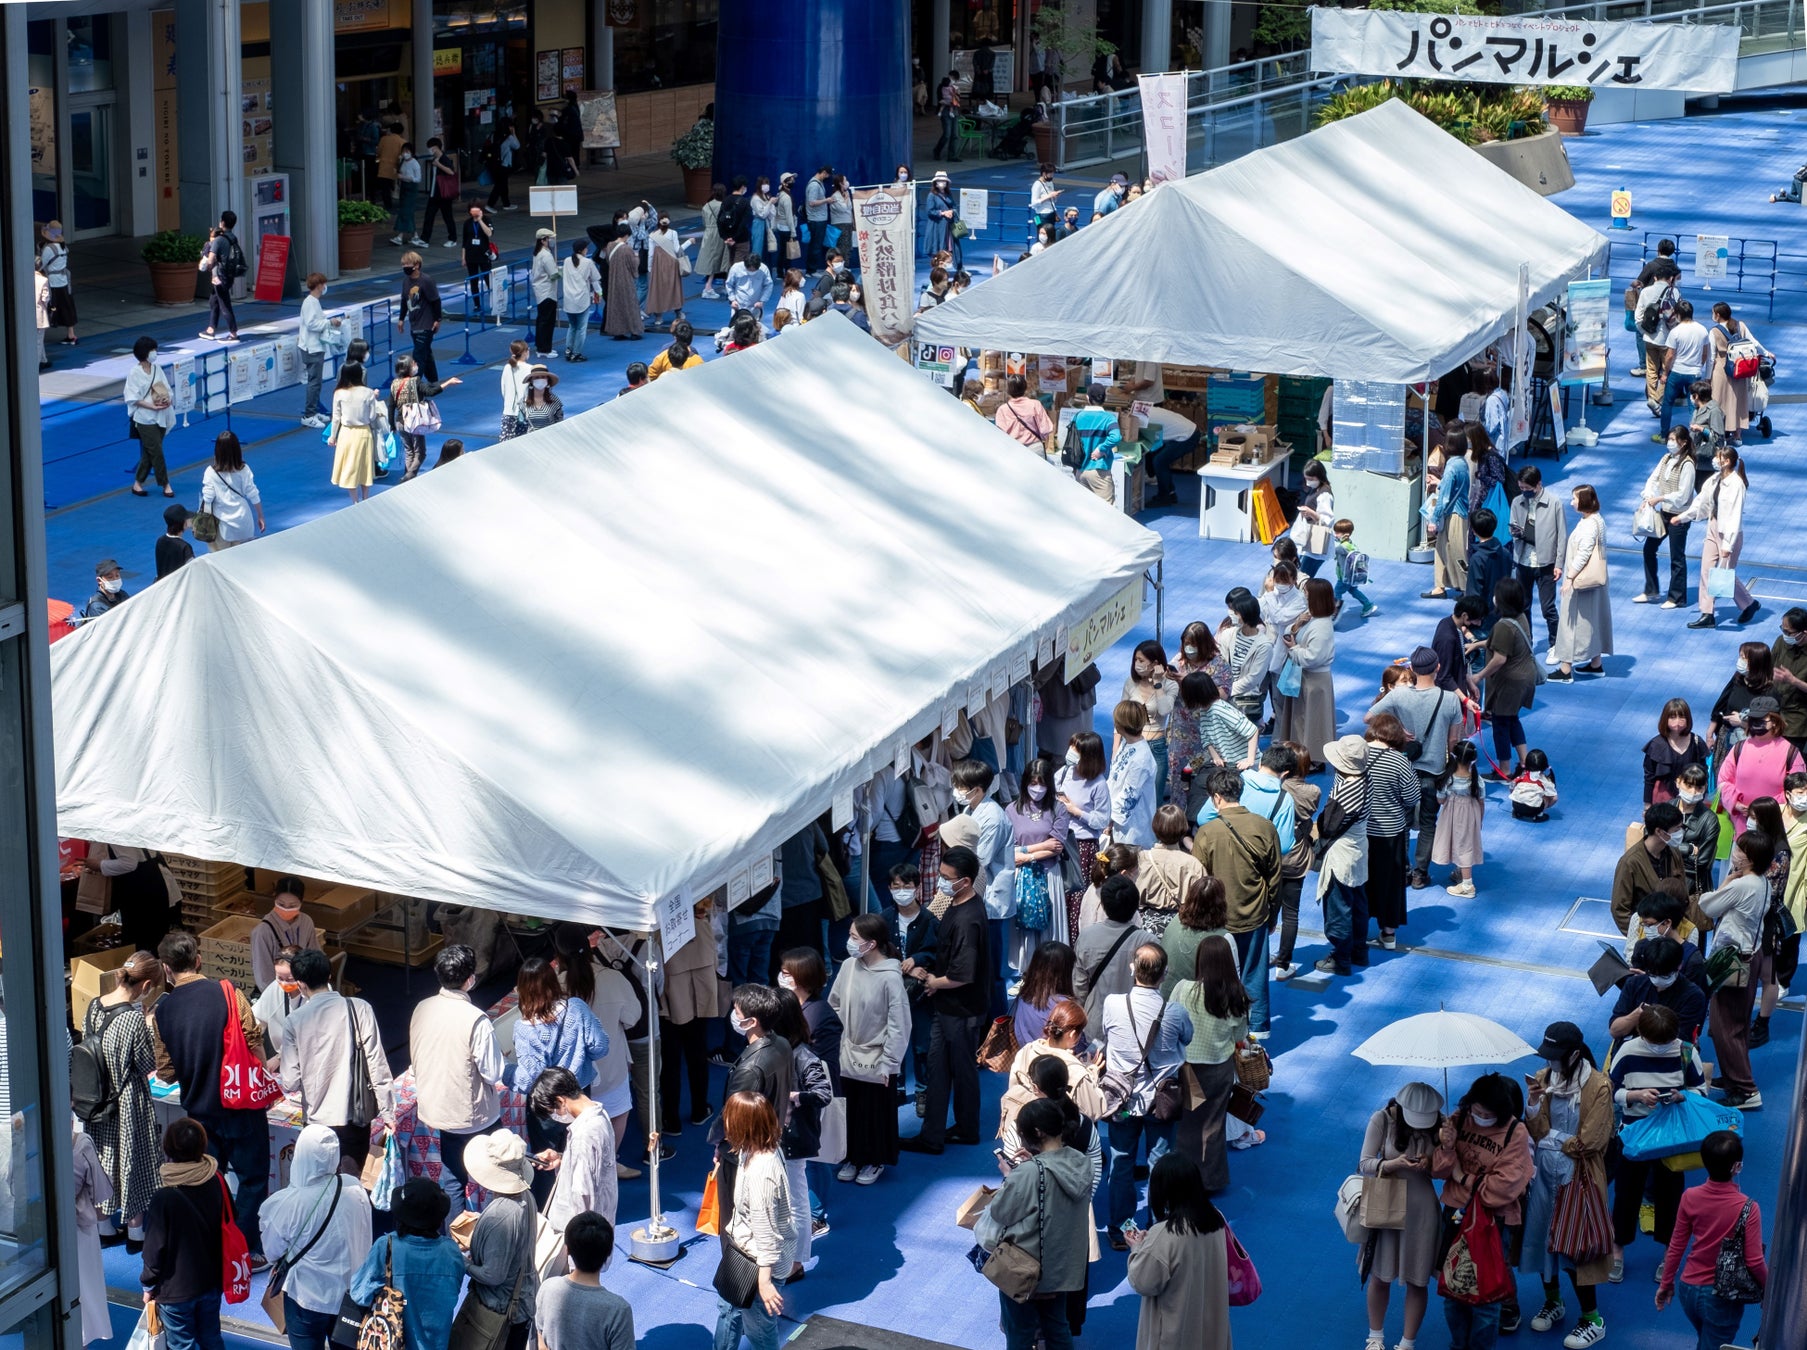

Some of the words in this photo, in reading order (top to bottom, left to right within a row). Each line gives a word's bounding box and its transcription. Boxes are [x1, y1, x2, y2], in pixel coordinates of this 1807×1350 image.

[1396, 17, 1643, 84] パンマルシェ
[1083, 601, 1126, 652] パンマルシェ
[667, 928, 690, 951] コーナー
[852, 1061, 875, 1069] coen
